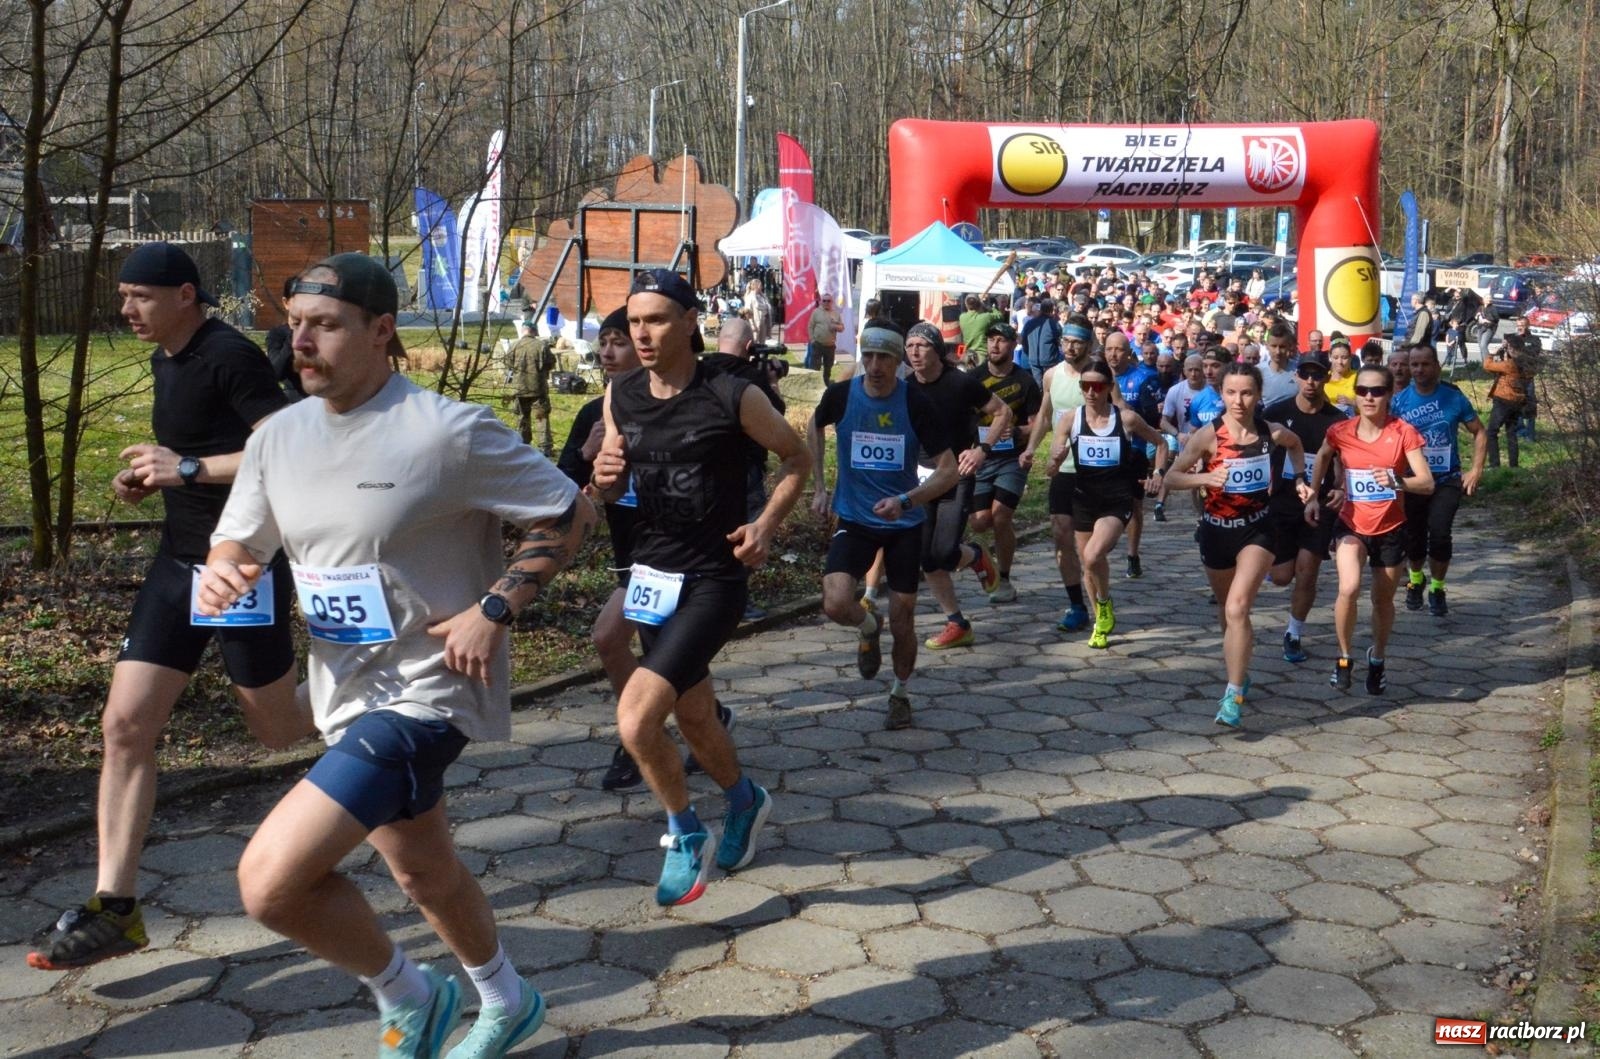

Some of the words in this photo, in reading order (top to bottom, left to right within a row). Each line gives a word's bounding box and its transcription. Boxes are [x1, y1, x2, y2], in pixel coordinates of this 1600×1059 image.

[1029, 140, 1065, 155] SIR
[1124, 134, 1178, 147] BIEG
[1081, 156, 1226, 173] TWARDZIELA
[1096, 178, 1210, 197] RACIBÓRZ
[1401, 400, 1440, 421] MORSY
[860, 445, 895, 461] 003
[1086, 446, 1111, 458] 031
[1232, 468, 1264, 483] 090
[632, 584, 662, 609] 051
[311, 593, 367, 624] 055
